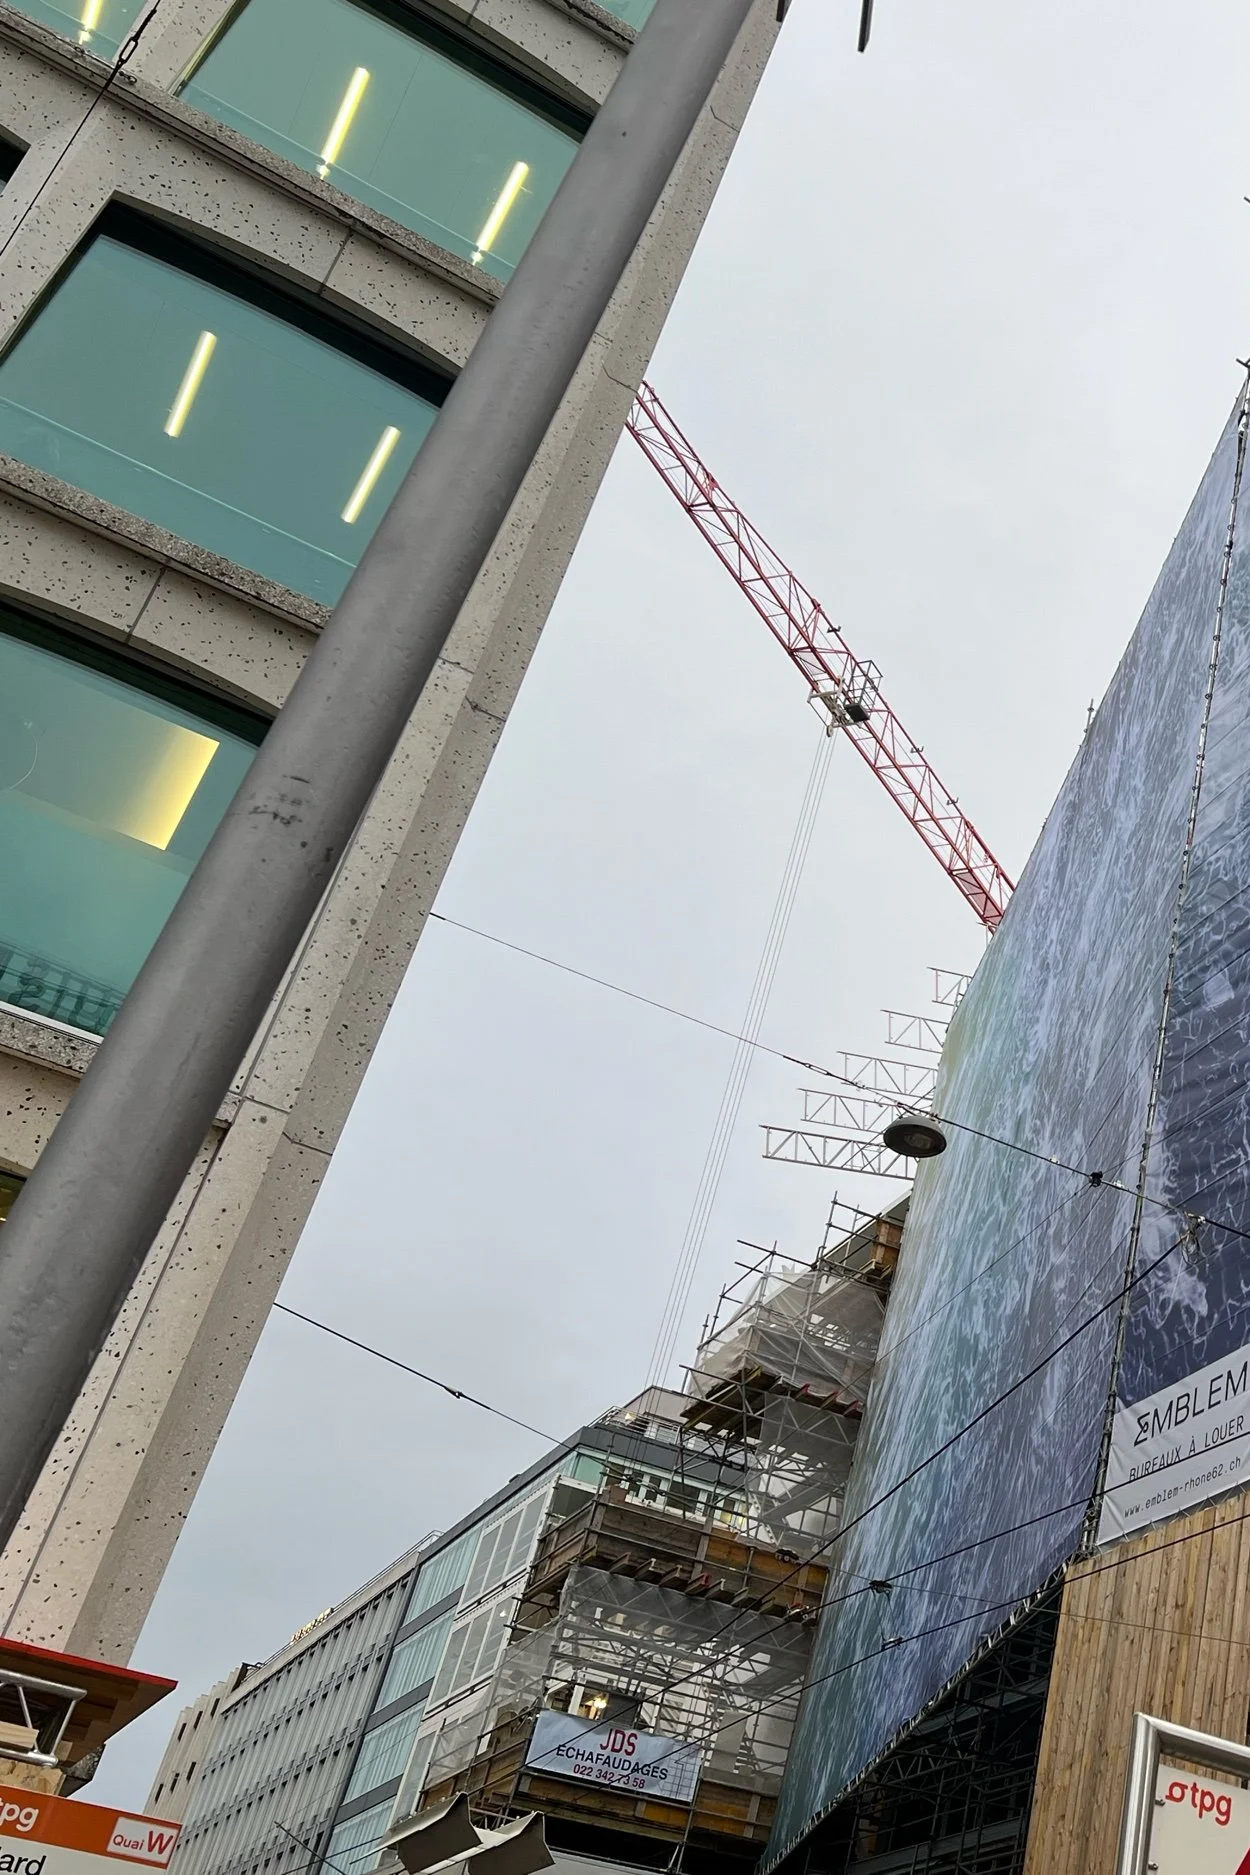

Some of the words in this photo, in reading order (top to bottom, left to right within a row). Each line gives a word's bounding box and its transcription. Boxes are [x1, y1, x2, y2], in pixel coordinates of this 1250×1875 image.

[1129, 1445, 1183, 1481] BUREAUX
[1188, 1435, 1196, 1456] À
[1204, 1415, 1245, 1448] LOUER
[1124, 1456, 1241, 1518] www.emblem-rhone62.ch
[600, 1728, 638, 1756] JDS
[573, 1764, 592, 1777] 022
[595, 1768, 614, 1782] 342
[632, 1777, 646, 1789] 58
[113, 1834, 144, 1851] Quai
[147, 1830, 174, 1855] W
[0, 1848, 47, 1875] ard
